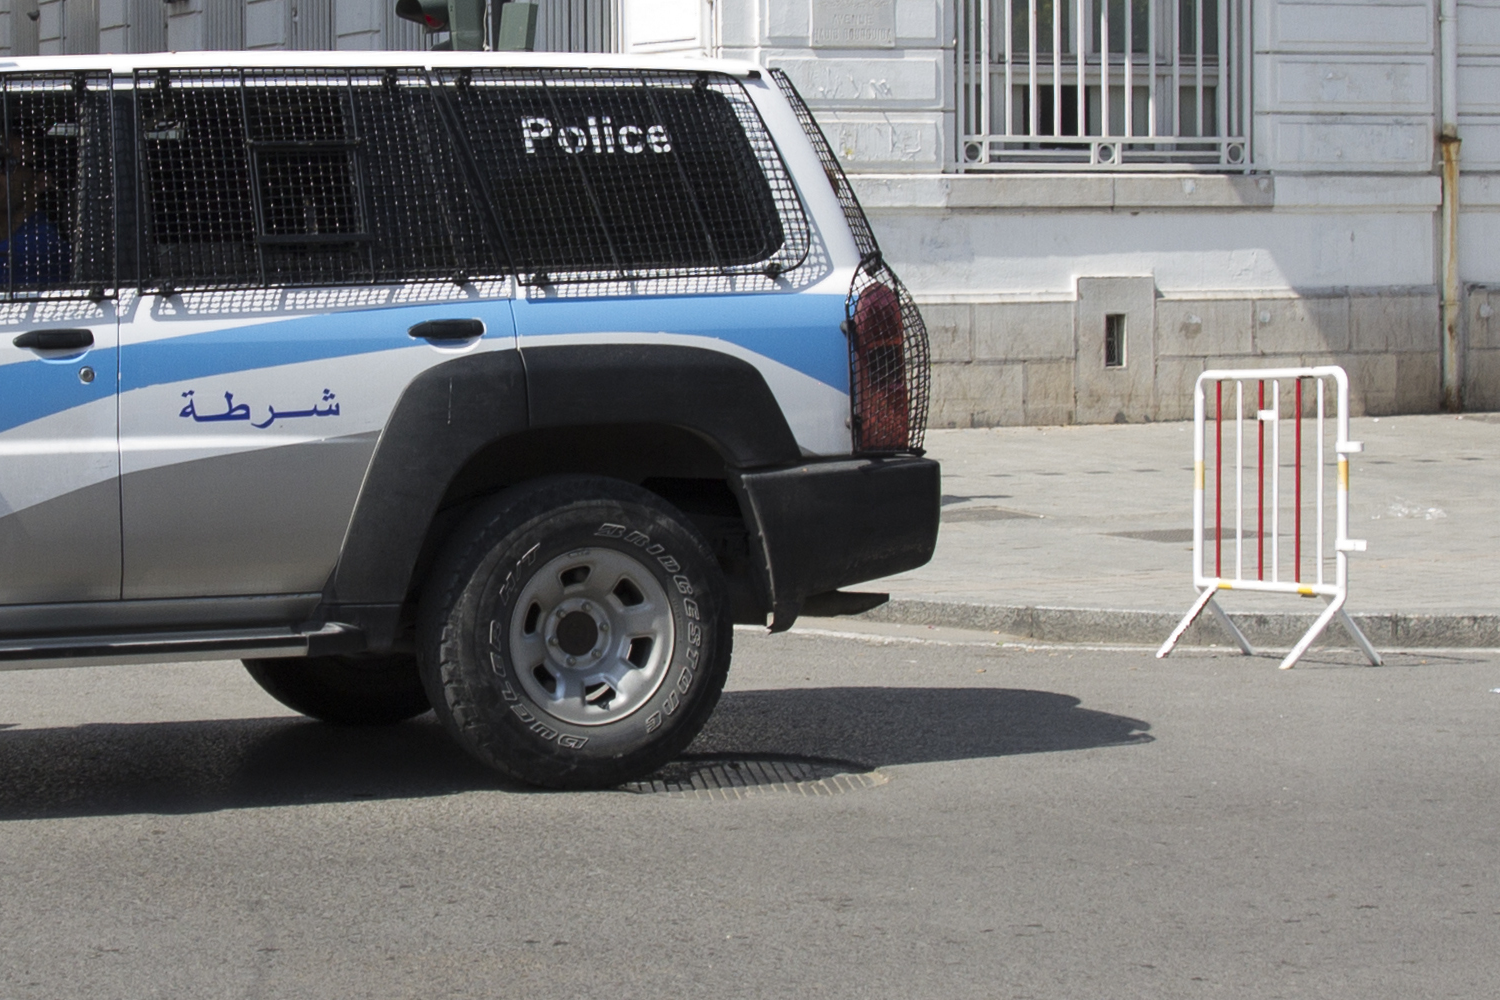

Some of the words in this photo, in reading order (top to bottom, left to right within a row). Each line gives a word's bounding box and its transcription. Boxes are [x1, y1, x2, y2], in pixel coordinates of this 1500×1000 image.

[521, 116, 672, 154] Police
[179, 388, 340, 429] شرطة
[594, 522, 701, 734] BRIDGESTONE
